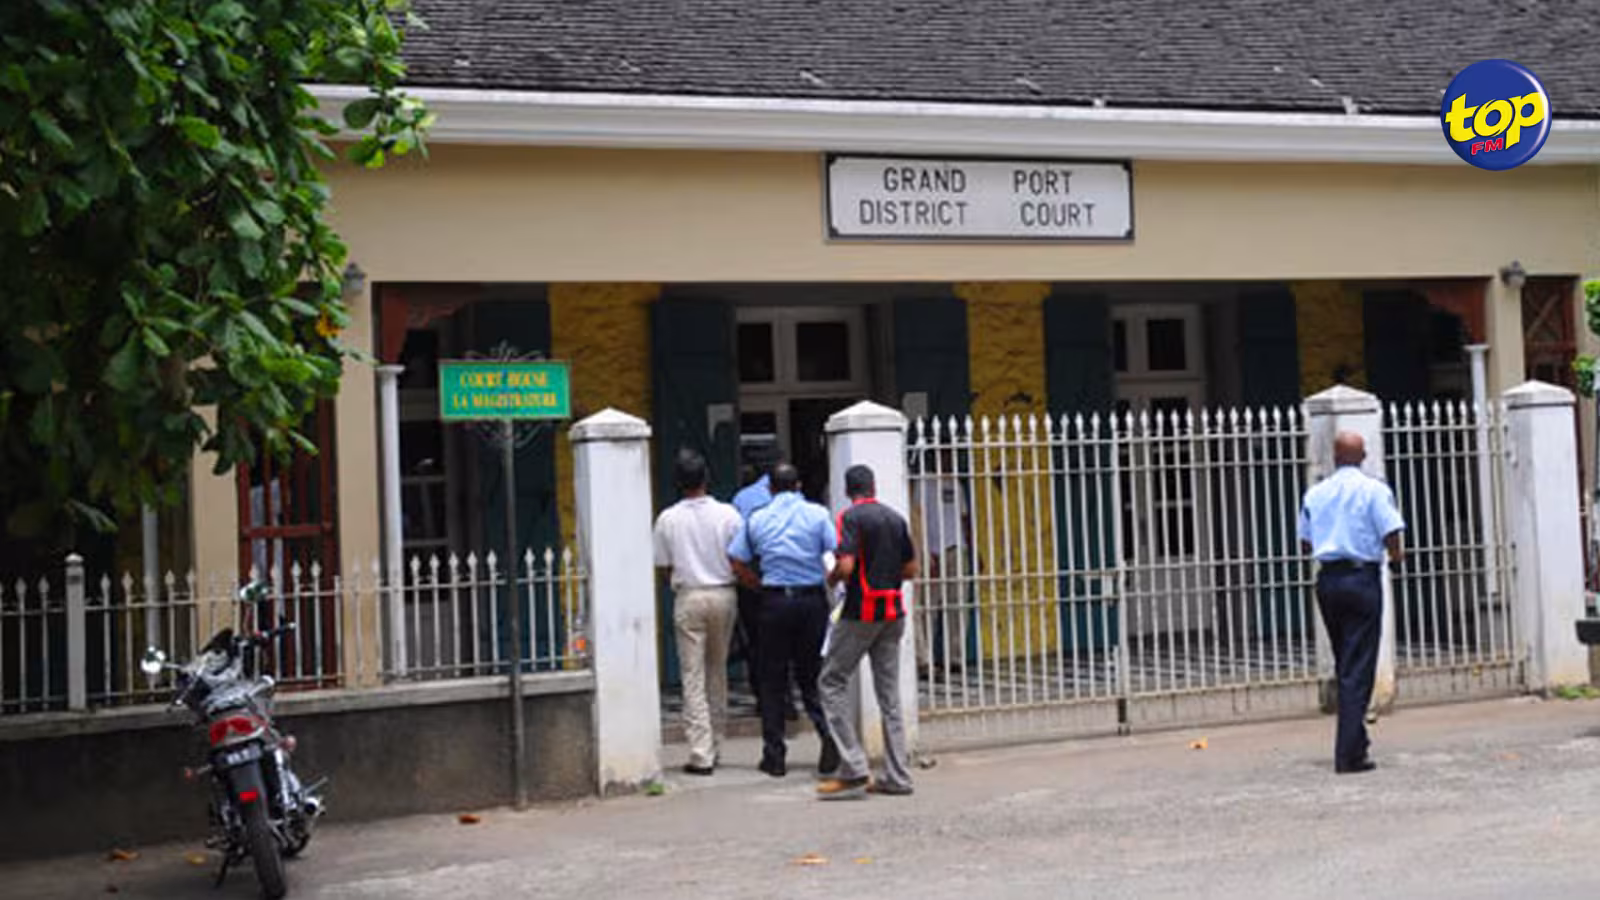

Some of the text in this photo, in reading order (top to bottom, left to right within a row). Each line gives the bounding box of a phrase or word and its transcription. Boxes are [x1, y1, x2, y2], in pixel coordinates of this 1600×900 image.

[882, 166, 1074, 196] GRAND PORT
[859, 199, 1096, 228] DISTRICT COURT
